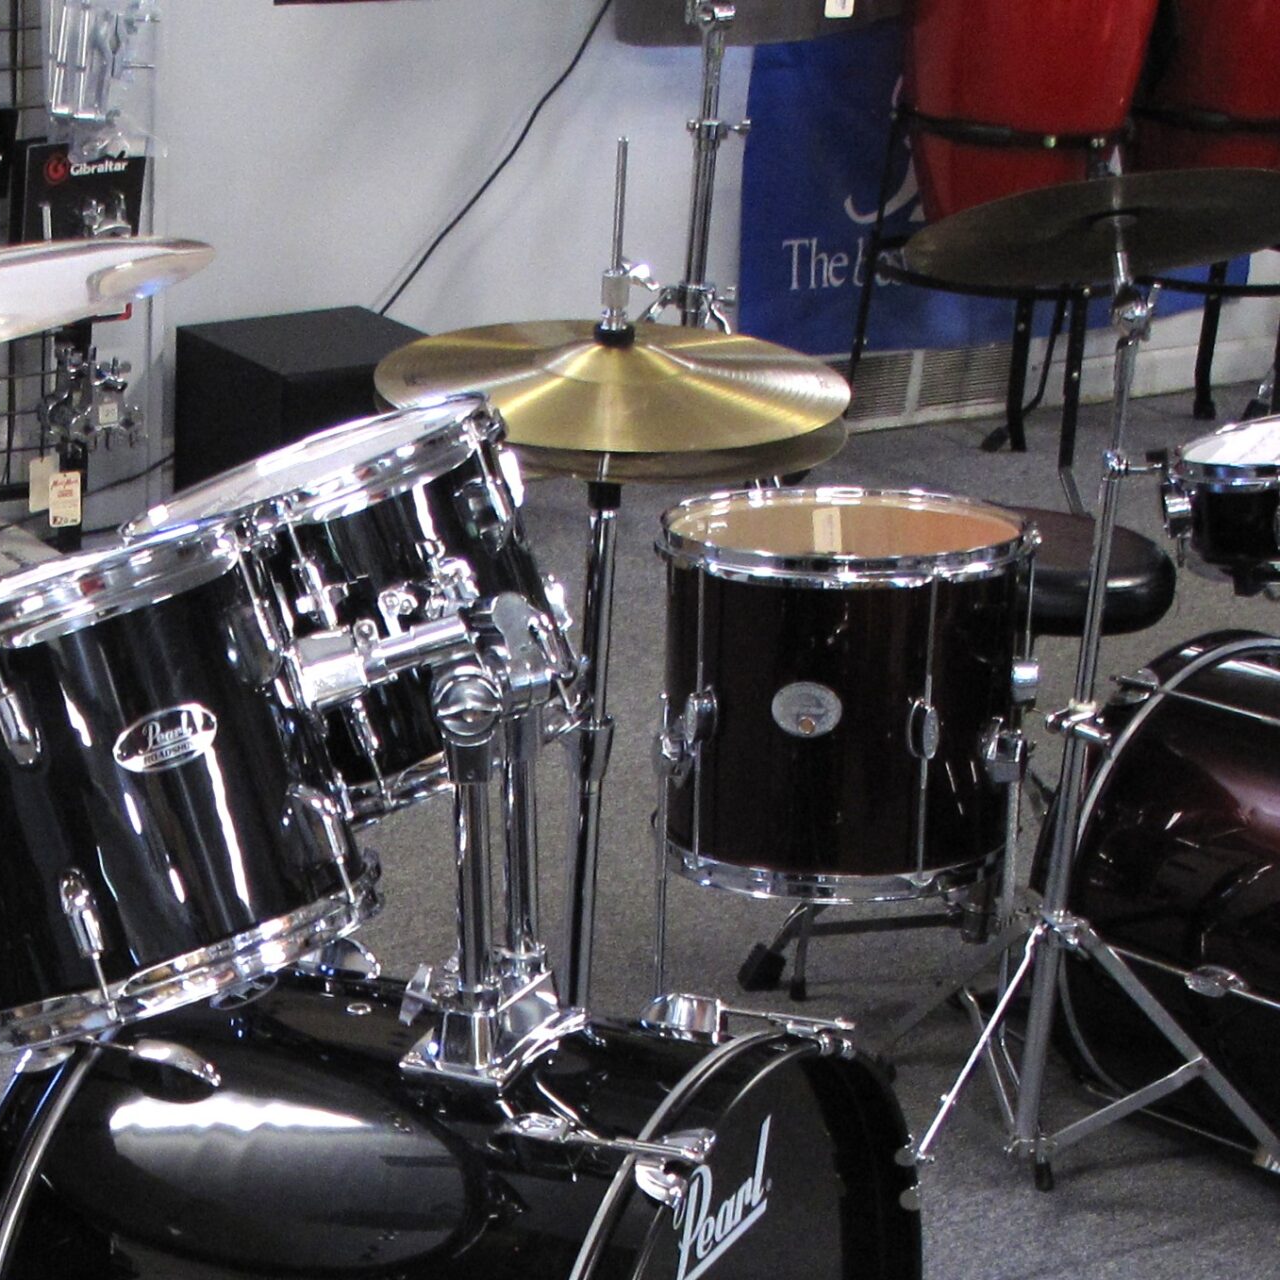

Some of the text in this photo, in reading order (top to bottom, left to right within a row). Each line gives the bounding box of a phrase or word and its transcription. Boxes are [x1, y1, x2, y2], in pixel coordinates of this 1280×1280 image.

[70, 160, 129, 176] Gibraltar
[782, 237, 849, 290] The
[140, 711, 194, 752] Pearl
[144, 740, 198, 766] ROADSHO
